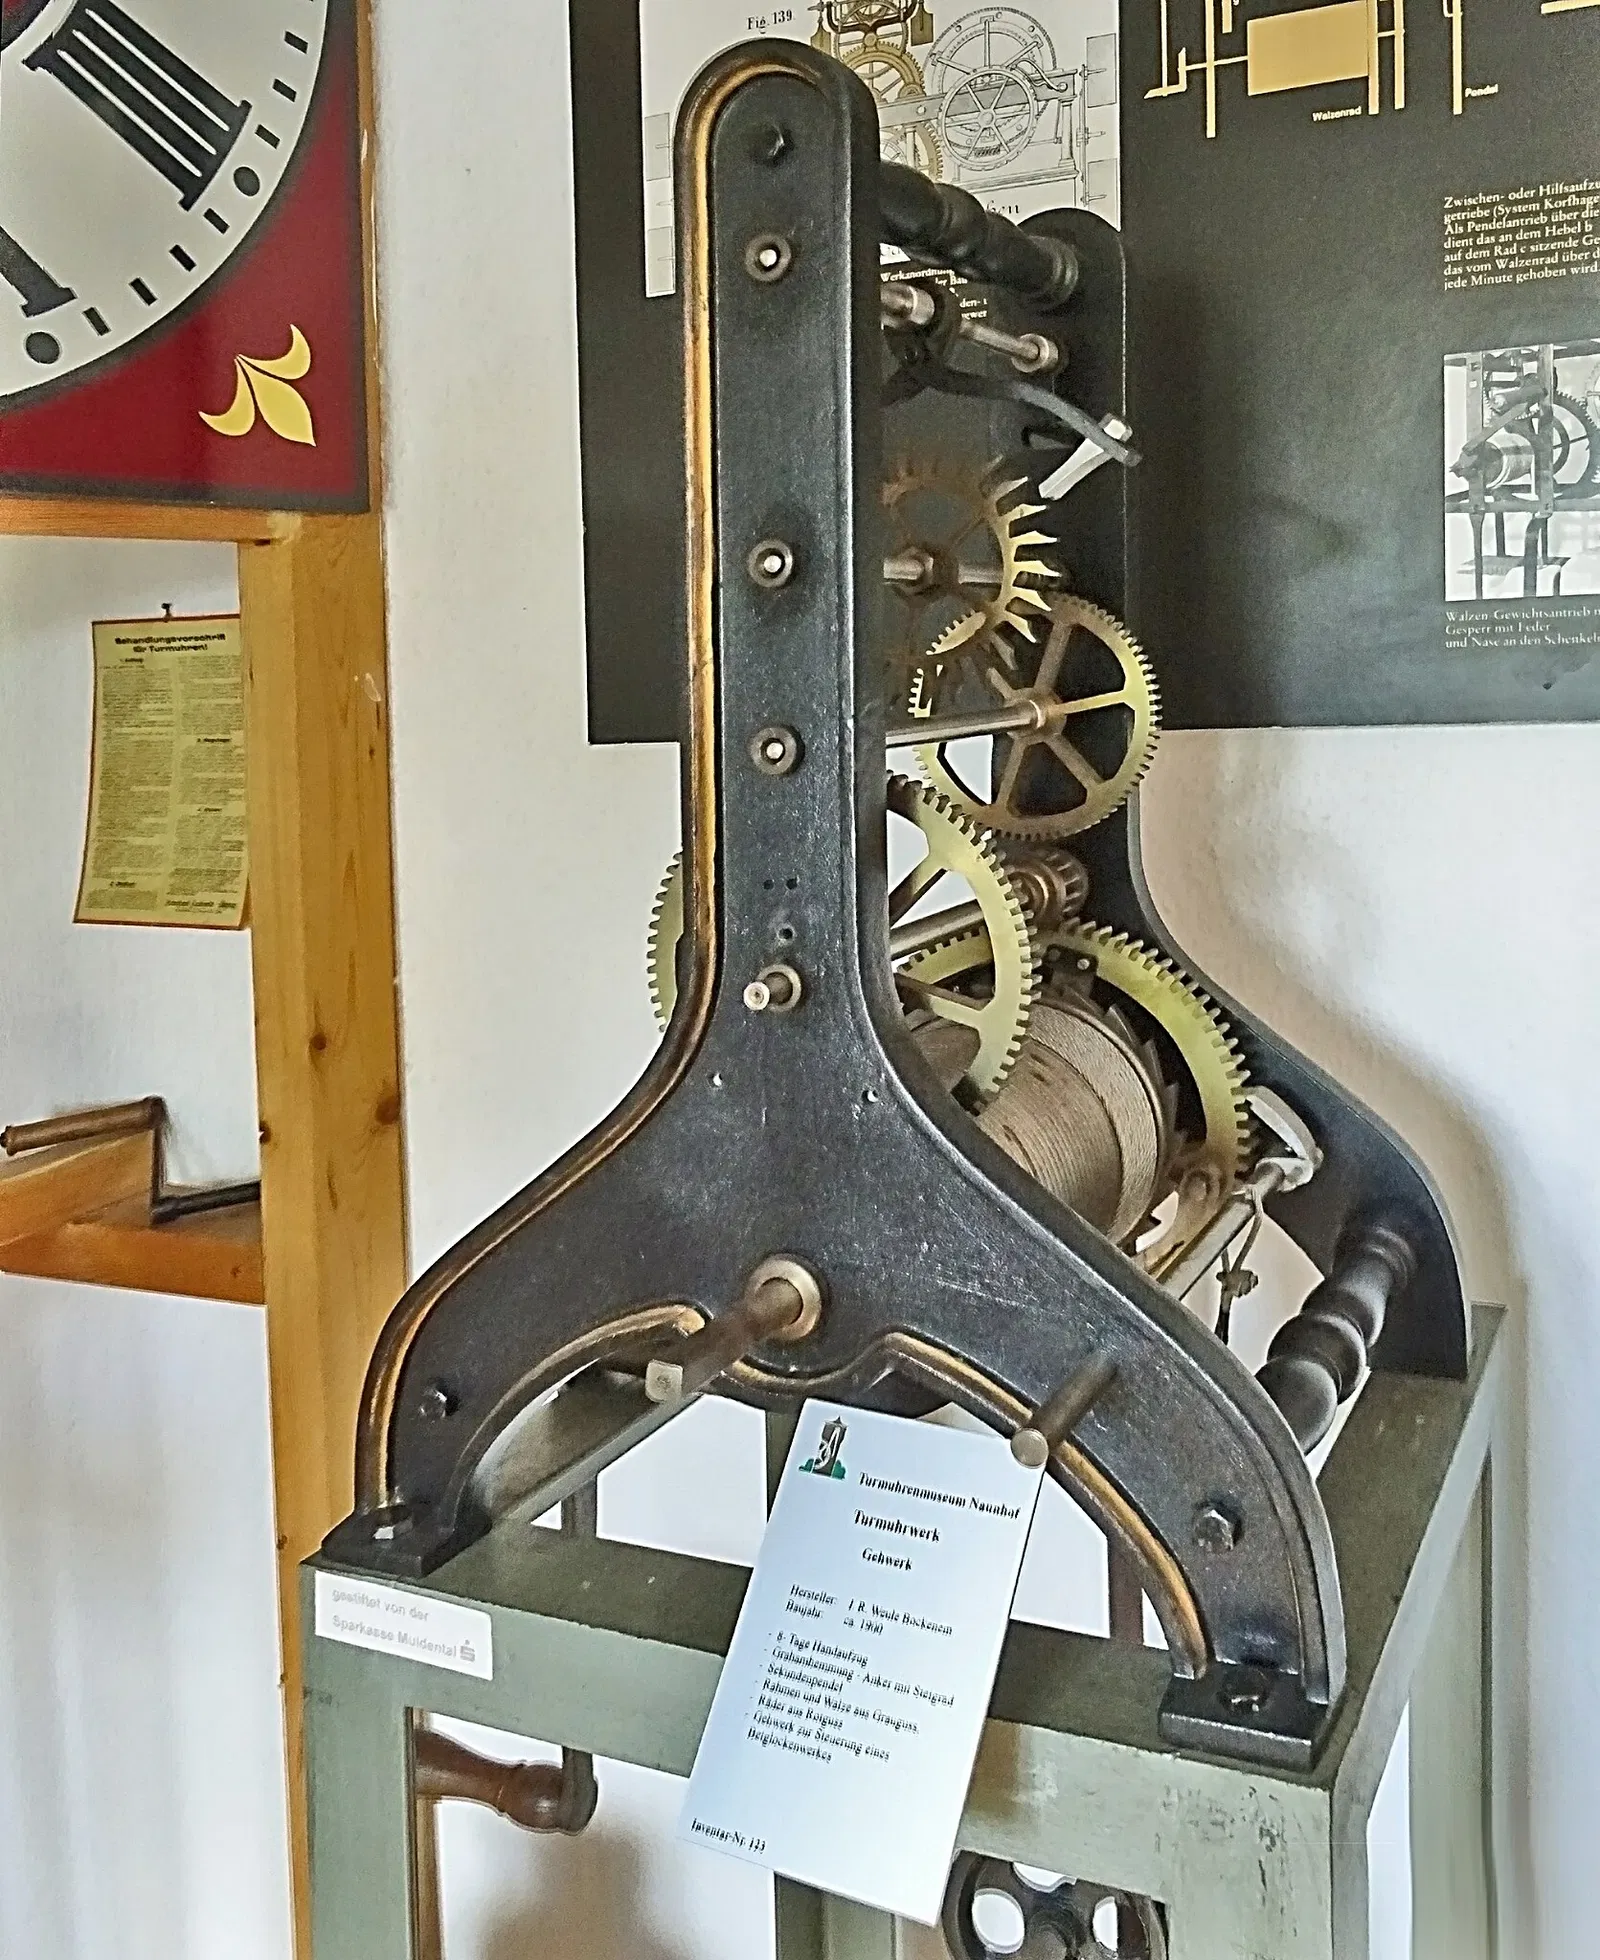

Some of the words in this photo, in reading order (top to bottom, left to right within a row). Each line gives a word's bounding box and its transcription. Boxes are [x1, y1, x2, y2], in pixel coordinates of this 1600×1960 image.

[747, 16, 770, 34] Fig.
[1312, 105, 1361, 122] Walzenrad
[1444, 192, 1505, 209] Zwischen-
[1508, 187, 1536, 201] oder
[1444, 207, 1490, 225] getriebe
[1493, 202, 1540, 218] (System
[1444, 223, 1464, 235] Als
[1467, 213, 1548, 233] Pendelantrieb
[1551, 209, 1579, 222] über
[1581, 205, 1600, 218] die
[1444, 237, 1473, 249] dient
[1476, 233, 1495, 245] das
[1499, 232, 1513, 242] an
[1516, 229, 1541, 241] dem
[1544, 221, 1581, 237] Hebel
[1584, 221, 1593, 232] b
[1444, 250, 1463, 262] auf
[1465, 248, 1490, 260] dem
[1494, 243, 1517, 256] Rad
[1529, 237, 1579, 252] sitzende
[1444, 264, 1463, 276] das
[1466, 262, 1492, 273] vom
[1496, 252, 1559, 270] Walzenrad
[1562, 251, 1590, 262] über
[1444, 278, 1468, 291] jede
[1471, 273, 1513, 287] Minute
[1516, 267, 1567, 284] gehoben
[1445, 624, 1491, 637] Gesperr
[1494, 623, 1513, 633] mit
[1518, 620, 1551, 633] Feder
[1445, 637, 1468, 649] und
[1471, 637, 1499, 648] Nase
[1503, 636, 1517, 646] an
[1519, 634, 1541, 645] den
[859, 1472, 966, 1508] Turmuhrenmuseum
[969, 1497, 1021, 1520] Naunhof
[854, 1509, 940, 1543] Turmuhrwerk
[862, 1547, 912, 1571] Gehwerk
[332, 1589, 381, 1609] gestiftet
[385, 1600, 406, 1616] von
[409, 1604, 430, 1622] der
[332, 1614, 394, 1641] Sparkasse
[789, 1633, 810, 1651] Tage
[812, 1639, 869, 1669] Handaufzug
[767, 1662, 844, 1695] Sekundenpendel
[772, 1646, 854, 1682] Grahamhemmung
[862, 1671, 891, 1689] Anker
[894, 1682, 911, 1695] mit
[762, 1678, 800, 1699] Rahmen
[803, 1690, 821, 1705] und
[824, 1694, 851, 1713] Walze
[854, 1705, 870, 1720] aus
[787, 1704, 803, 1718] aus
[753, 1710, 794, 1733] Gehwerk
[797, 1725, 812, 1738] zur
[865, 1744, 890, 1761] eines
